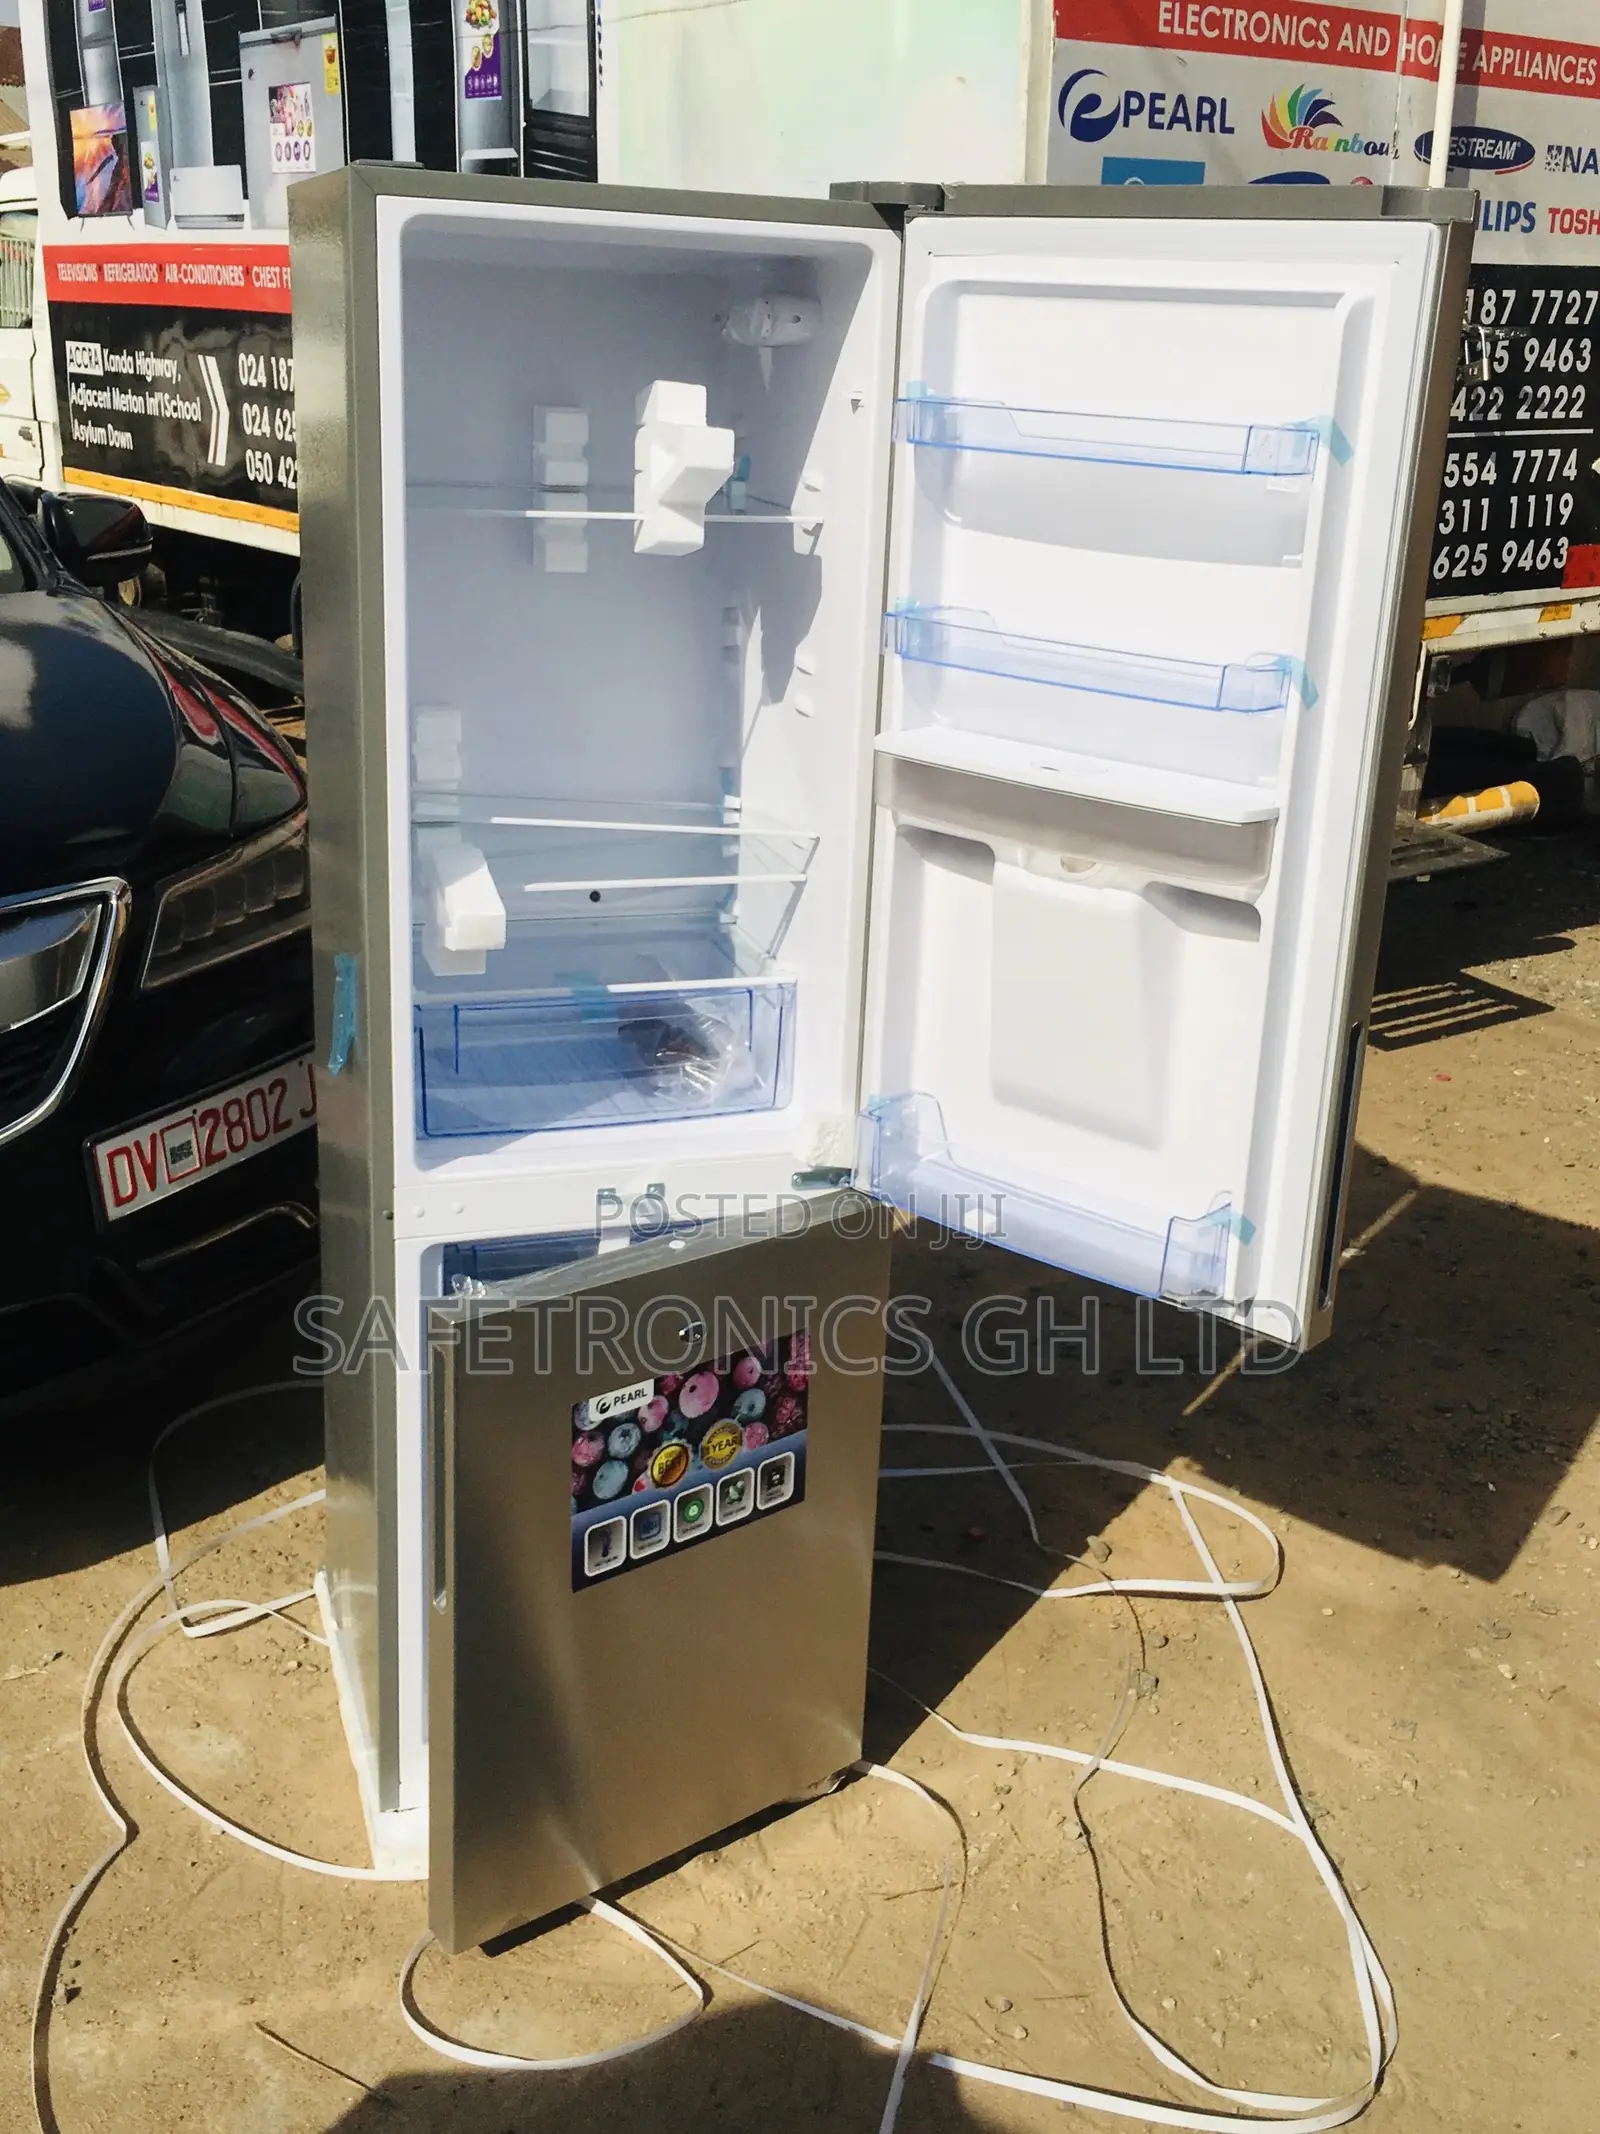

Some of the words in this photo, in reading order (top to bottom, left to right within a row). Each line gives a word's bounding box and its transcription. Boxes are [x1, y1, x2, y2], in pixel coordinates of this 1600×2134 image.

[1158, 1, 1331, 50] ELECTRONICS
[1336, 22, 1391, 56] AND
[1472, 44, 1598, 86] APPLIANCES
[1122, 90, 1235, 135] PEARL
[57, 262, 98, 282] TELEVISIONS
[165, 263, 245, 287] AIR-CONDITIONERS
[251, 265, 281, 289] CHEST
[282, 266, 292, 291] F
[1466, 288, 1517, 325] 187
[1530, 289, 1599, 325] 7727
[69, 345, 102, 370] ACCRA
[103, 348, 135, 375] Kanda
[135, 350, 181, 385] Highway,
[238, 352, 267, 389] 024
[270, 356, 295, 392] 187
[1523, 337, 1592, 373] 9463
[70, 381, 111, 412] Adjacent
[112, 386, 145, 415] Merton
[164, 392, 202, 422] School
[242, 402, 271, 438] 024
[1449, 385, 1505, 422] 422
[1516, 384, 1586, 420] 2222
[73, 418, 108, 449] Asylum
[107, 423, 134, 451] Down
[245, 448, 274, 486] 050
[277, 455, 298, 490] 42
[1443, 451, 1497, 488] 554
[1511, 448, 1578, 484] 7774
[1438, 497, 1490, 535] 311
[1510, 492, 1574, 529] 1119
[1432, 542, 1488, 580] 625
[1501, 536, 1569, 574] 9463
[106, 1132, 157, 1208] DV
[199, 1077, 293, 1167] 2802
[613, 1387, 649, 1407] PEARL
